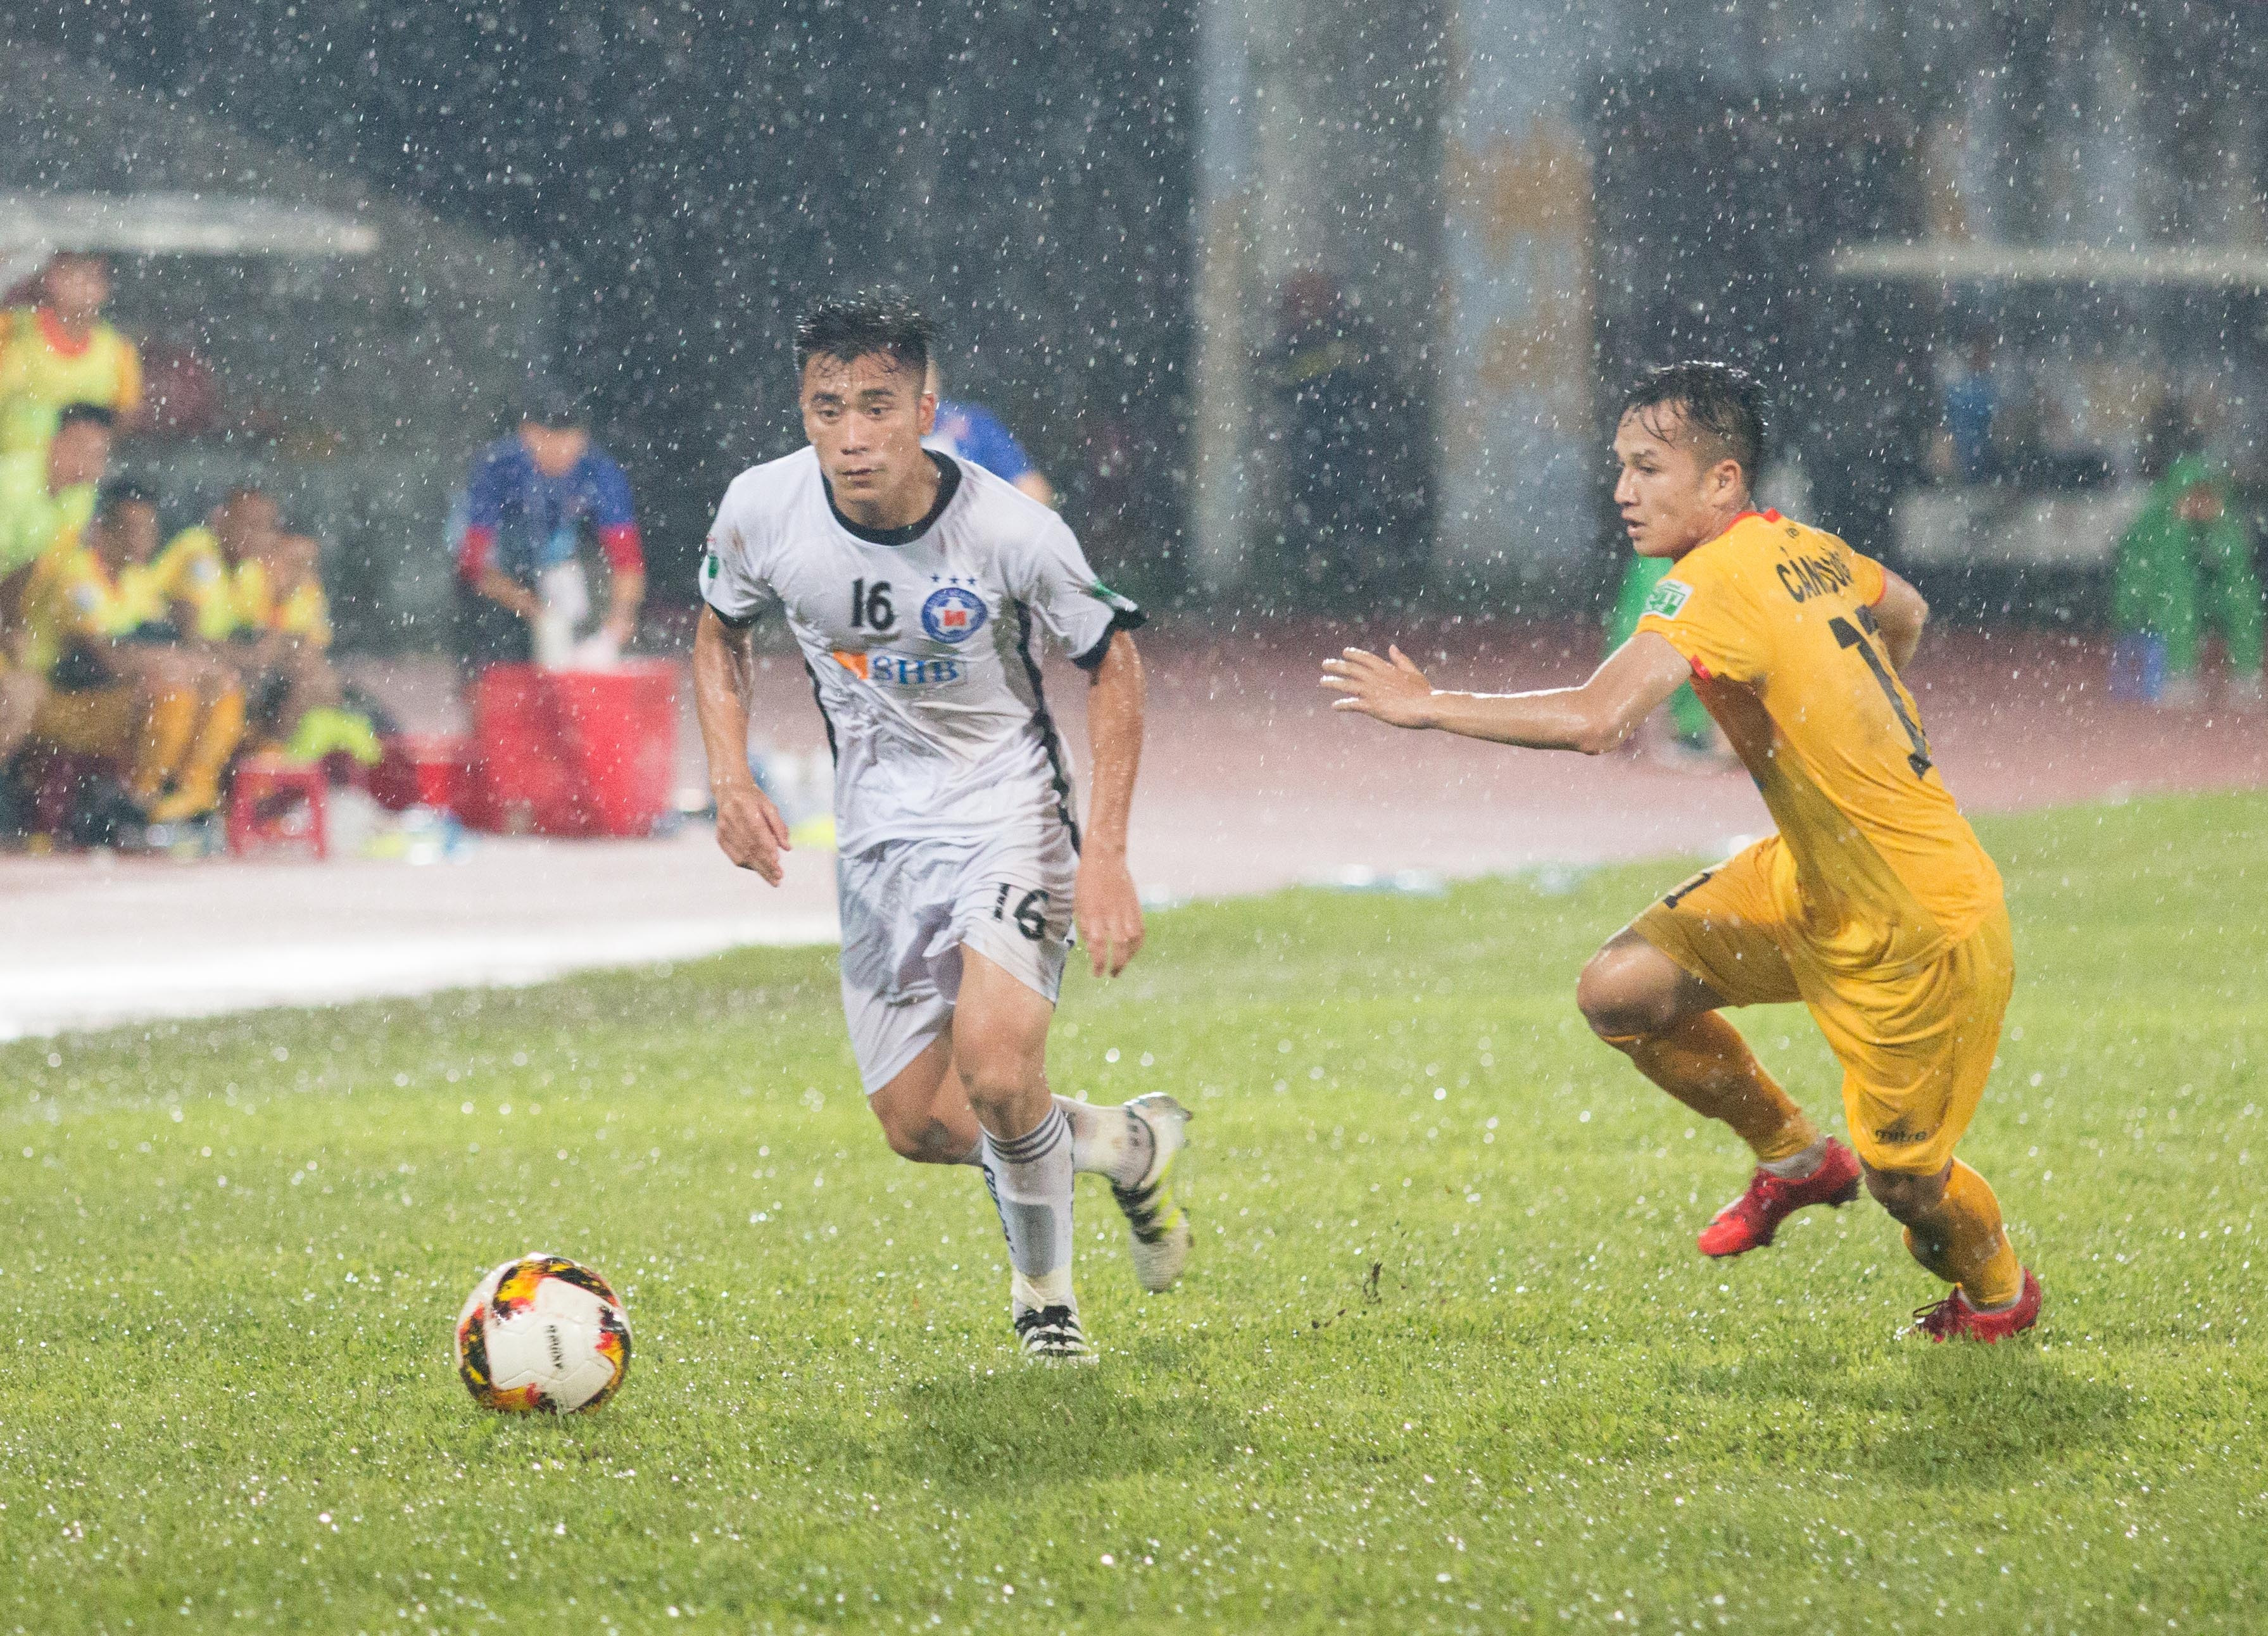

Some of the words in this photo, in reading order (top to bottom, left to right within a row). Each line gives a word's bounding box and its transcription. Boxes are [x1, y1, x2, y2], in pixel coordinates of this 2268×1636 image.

[851, 577, 896, 631] 16
[873, 655, 959, 685] SHB
[992, 882, 1050, 941] 16
